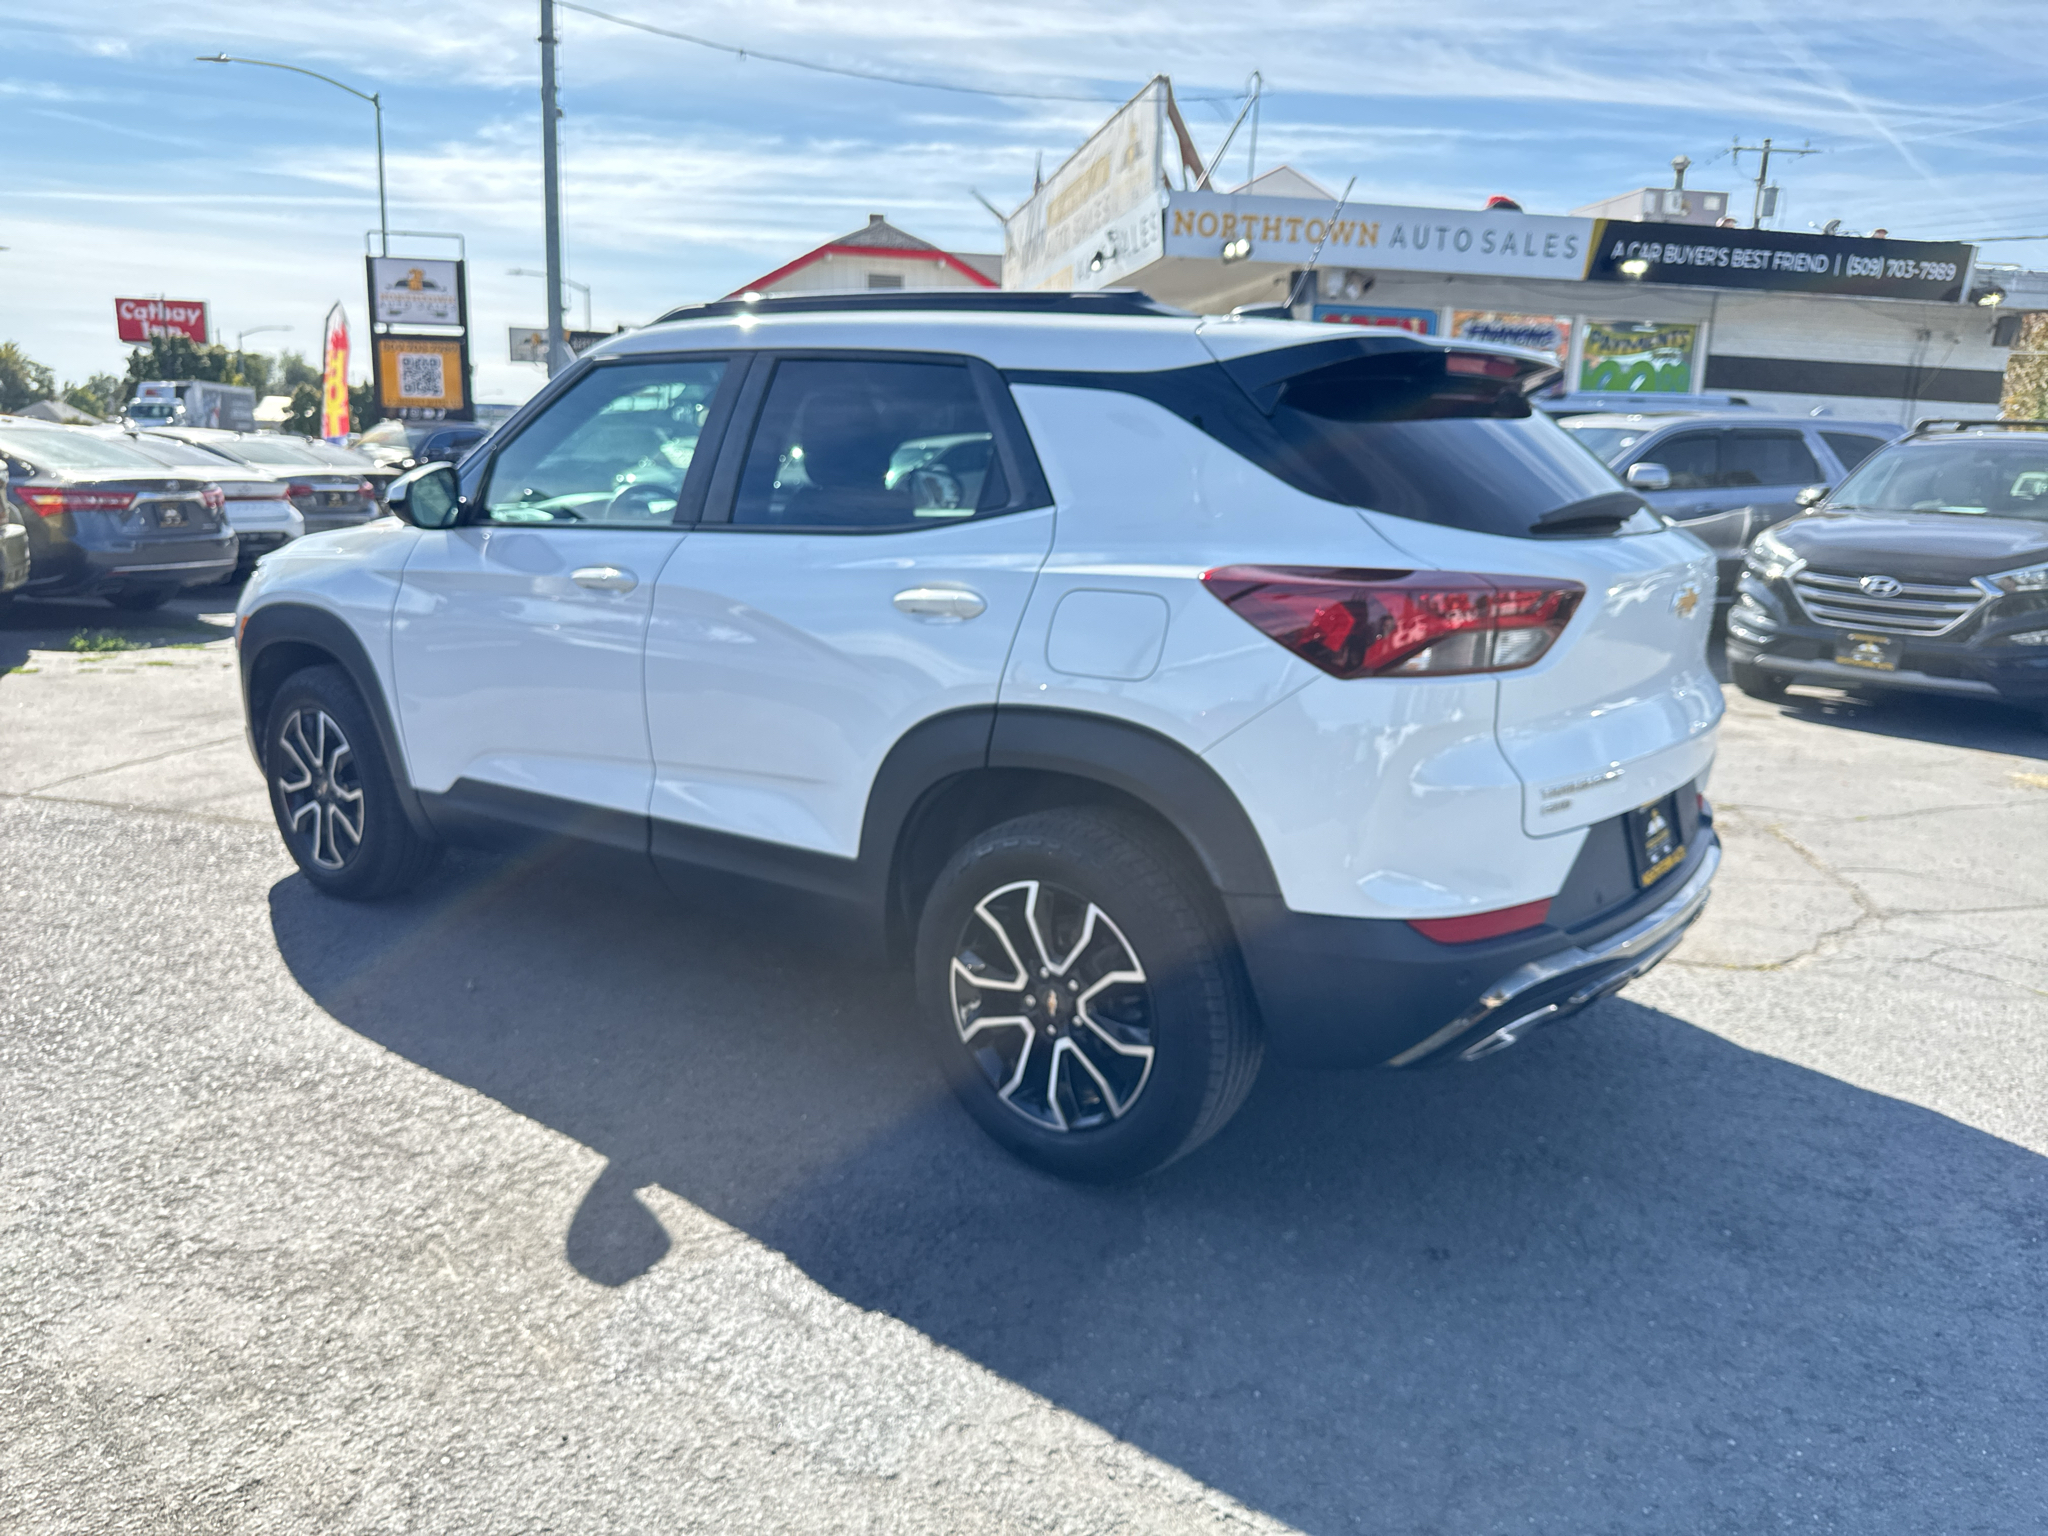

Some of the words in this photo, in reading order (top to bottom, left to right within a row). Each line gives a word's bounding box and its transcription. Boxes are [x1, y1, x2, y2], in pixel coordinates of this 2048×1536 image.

[1172, 209, 1379, 247] NORTHTOWN
[1389, 223, 1473, 252] AUTO
[1480, 228, 1580, 260] SALES
[1610, 240, 1625, 260] A
[1730, 248, 1773, 270] BEST
[1772, 251, 1829, 273] FRIEND
[1846, 254, 1884, 280] (509)
[1886, 258, 1957, 282] 703-7989
[120, 300, 201, 327] Cathay
